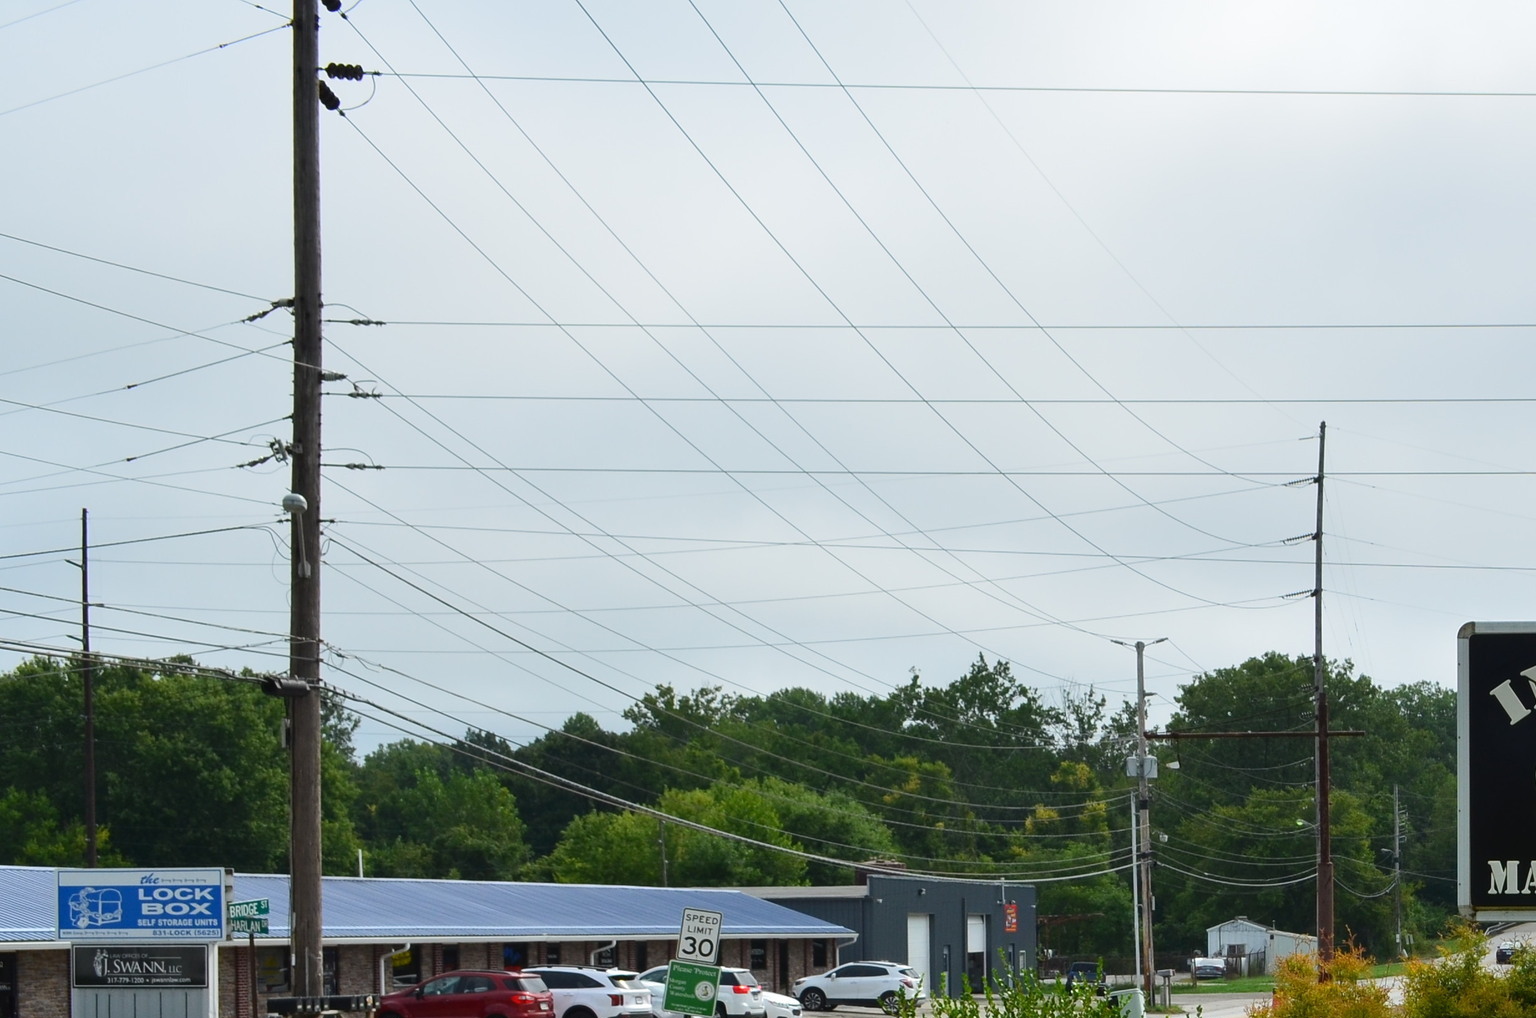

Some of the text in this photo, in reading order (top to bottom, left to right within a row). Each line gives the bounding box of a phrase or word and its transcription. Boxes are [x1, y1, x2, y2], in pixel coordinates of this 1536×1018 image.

[140, 873, 160, 885] the
[138, 887, 215, 901] LOCK
[141, 902, 213, 916] BOX
[229, 900, 268, 918] BRIDGE ST
[137, 918, 219, 927] SELF STORAGE UNITS
[230, 919, 261, 932] HARLAN
[685, 913, 719, 926] SPEED
[687, 925, 714, 936] LIMIT
[681, 936, 714, 957] 30
[103, 958, 110, 977] J.
[113, 958, 167, 974] SWANN,
[672, 964, 717, 977] Please Protect
